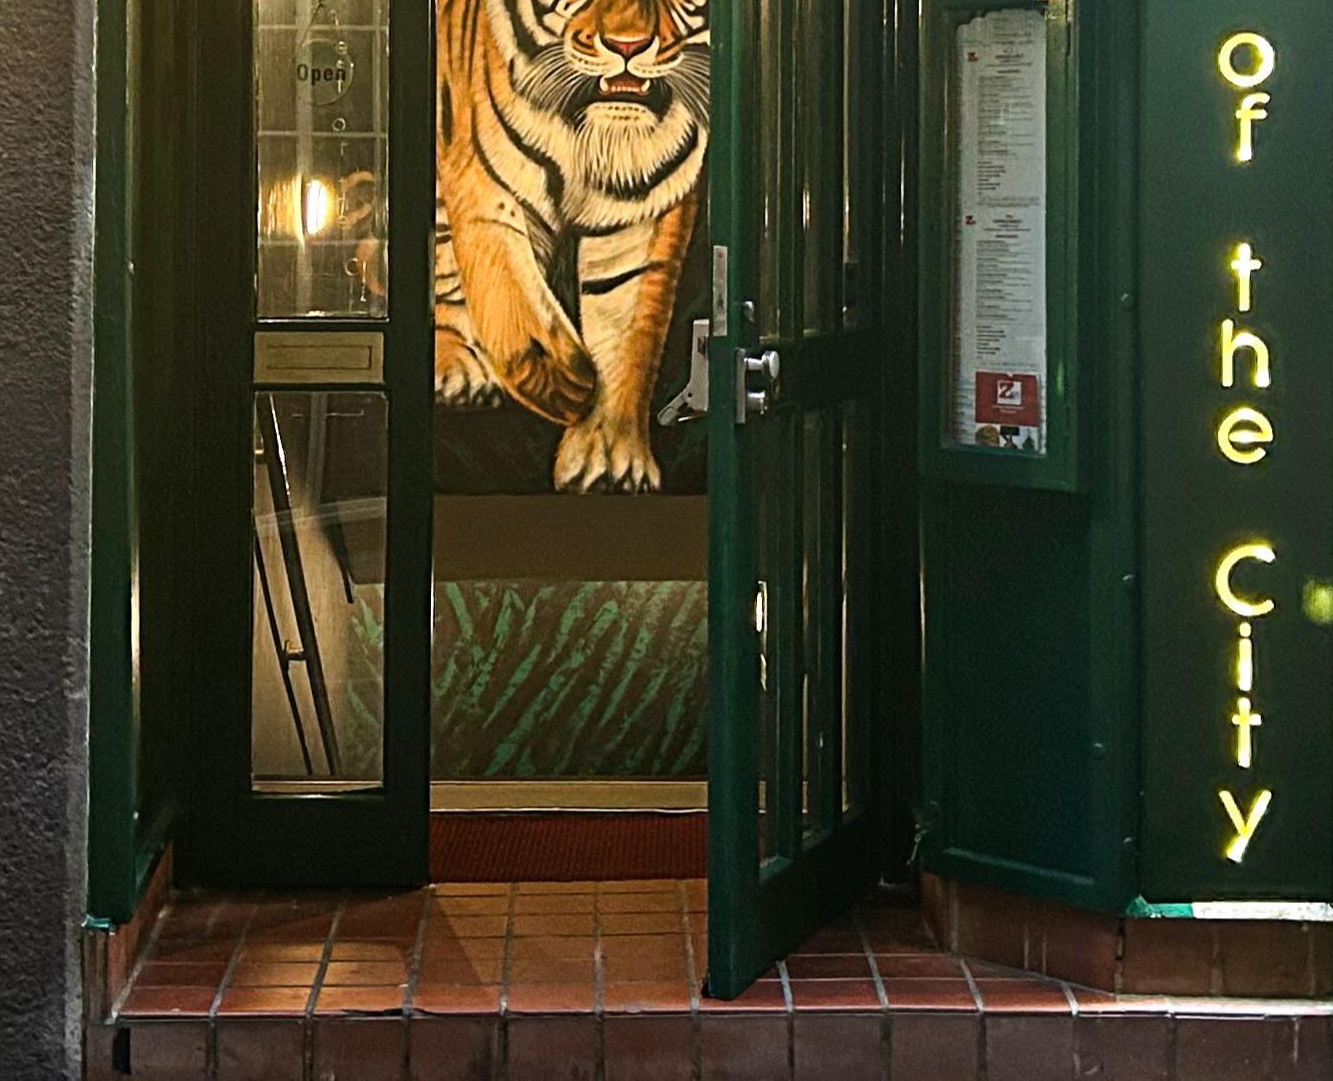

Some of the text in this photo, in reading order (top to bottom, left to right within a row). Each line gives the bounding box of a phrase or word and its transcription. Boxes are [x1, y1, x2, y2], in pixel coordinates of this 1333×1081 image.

[297, 64, 346, 86] Open
[1218, 32, 1276, 163] of
[1217, 242, 1274, 465] the
[1215, 544, 1276, 864] City
